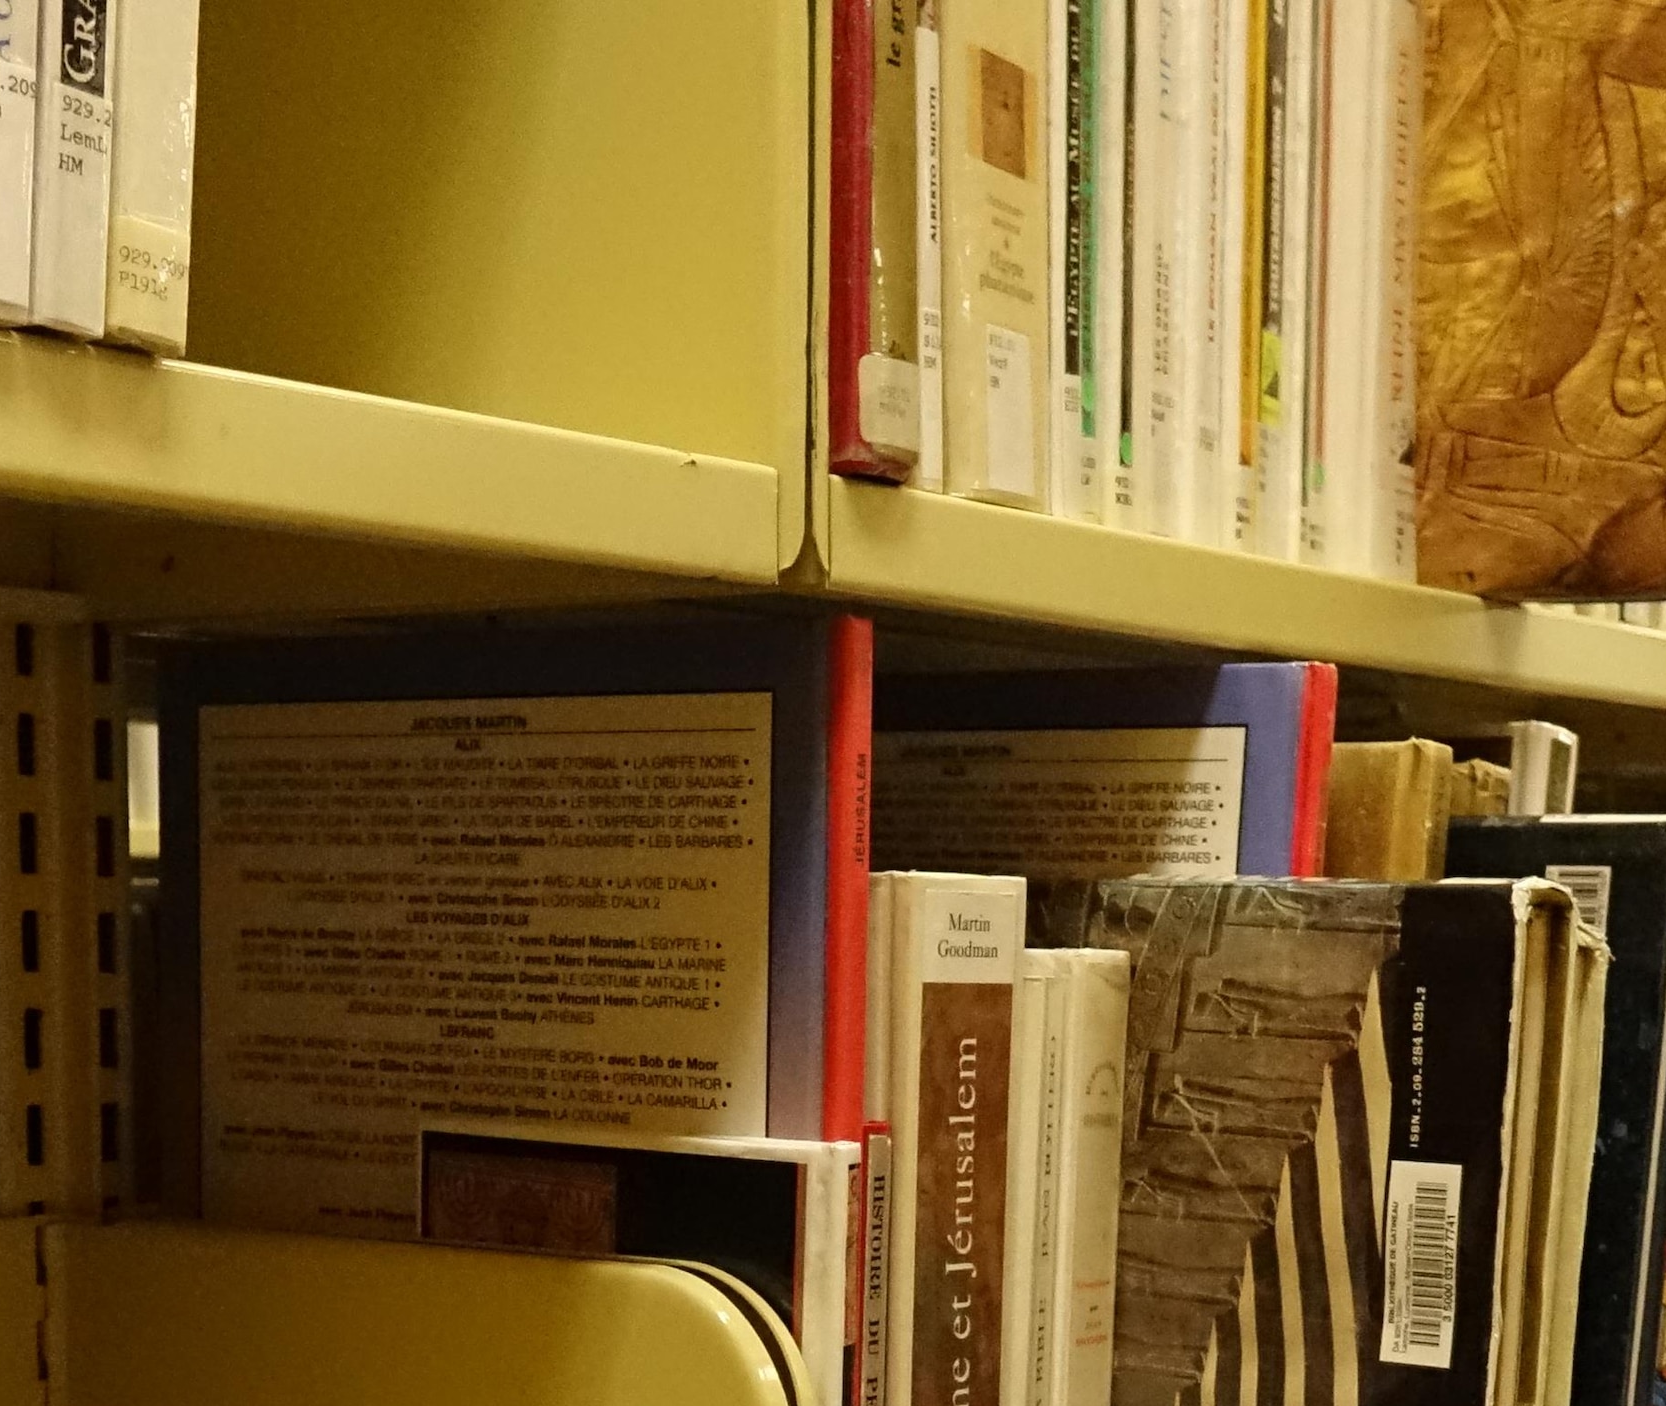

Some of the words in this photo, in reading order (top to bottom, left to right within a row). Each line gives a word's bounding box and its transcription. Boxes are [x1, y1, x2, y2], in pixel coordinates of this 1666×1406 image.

[58, 153, 84, 176] HM
[854, 753, 867, 867] JÉRUSALEM
[948, 912, 992, 934] Martin
[936, 939, 1000, 960] Goodman
[639, 1054, 664, 1070] Bob
[667, 1055, 683, 1070] de
[685, 1056, 720, 1072] Moor
[944, 1036, 978, 1279] Jérusalem
[869, 1175, 886, 1297] HISTOIRE
[1391, 1201, 1399, 1245] GATINEAU
[867, 1319, 880, 1357] DU
[946, 1294, 972, 1341] et
